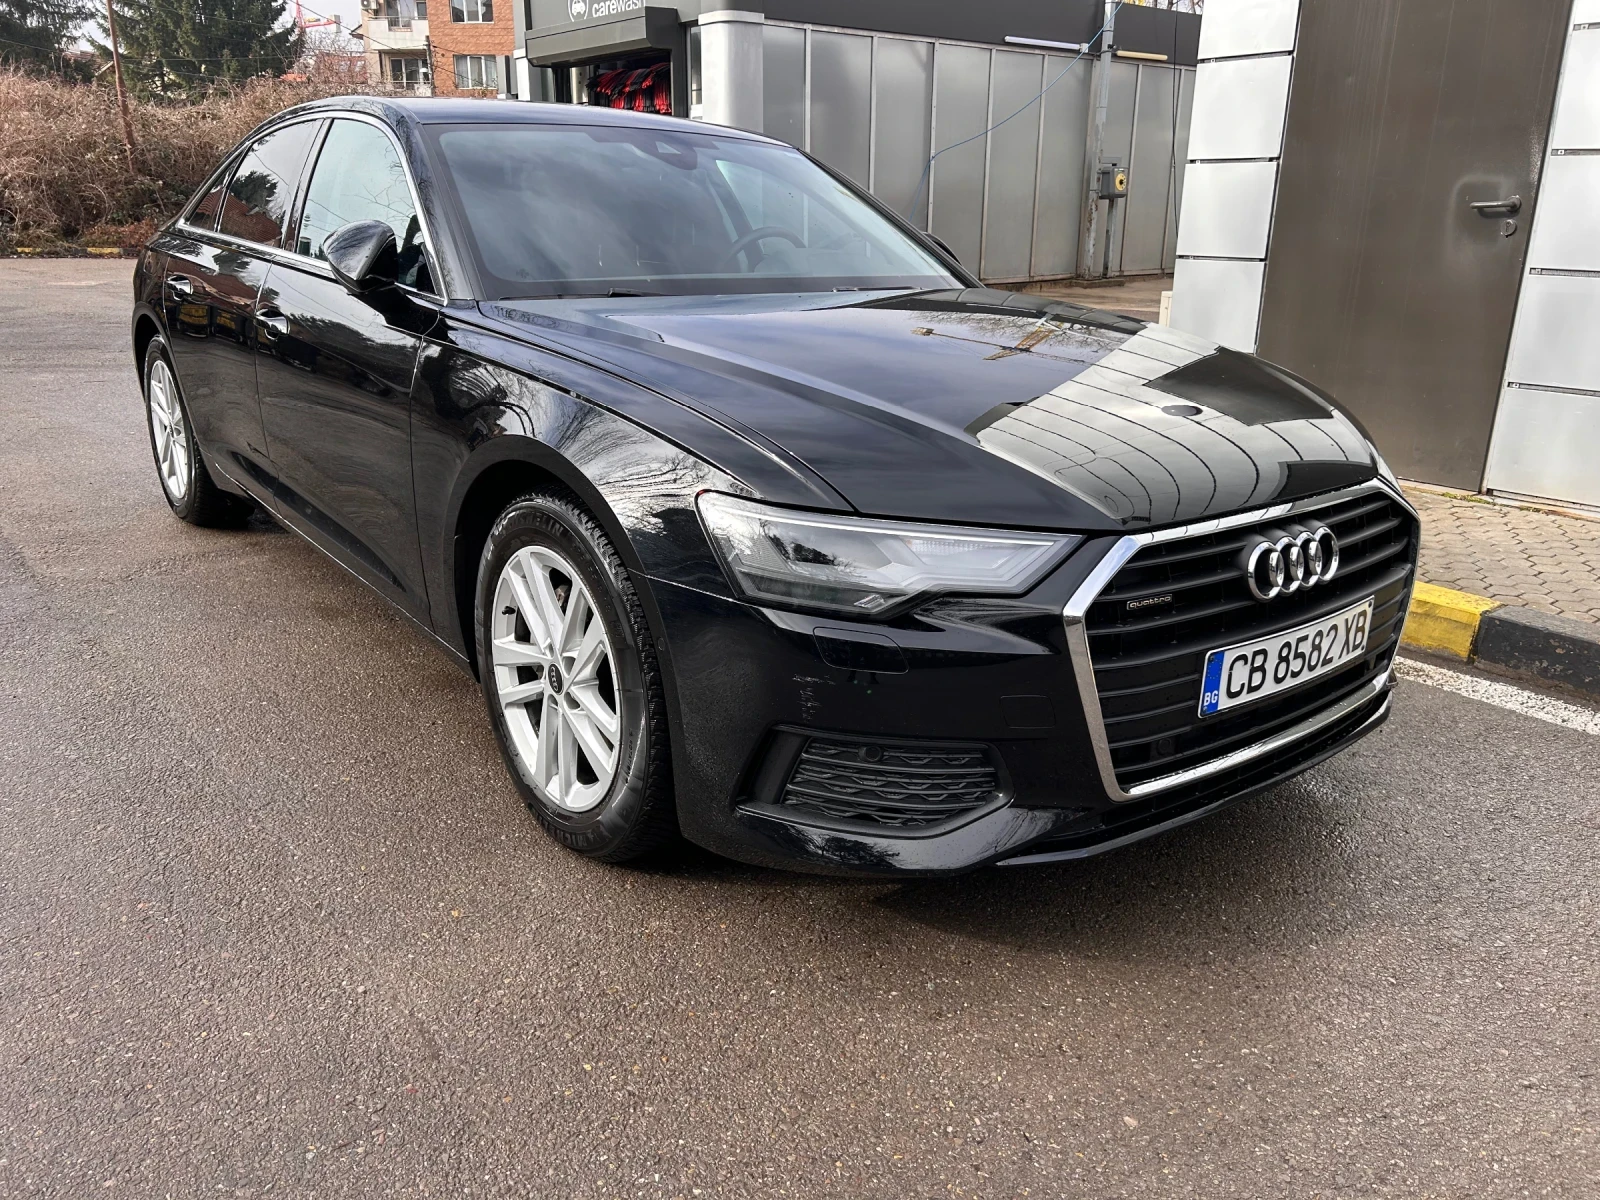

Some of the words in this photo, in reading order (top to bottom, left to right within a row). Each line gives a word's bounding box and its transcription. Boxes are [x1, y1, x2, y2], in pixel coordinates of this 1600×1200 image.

[1129, 596, 1171, 609] quattro
[1226, 648, 1268, 699] CB
[1273, 623, 1338, 685] 8582
[1338, 609, 1368, 660] XB
[1203, 690, 1219, 706] BG
